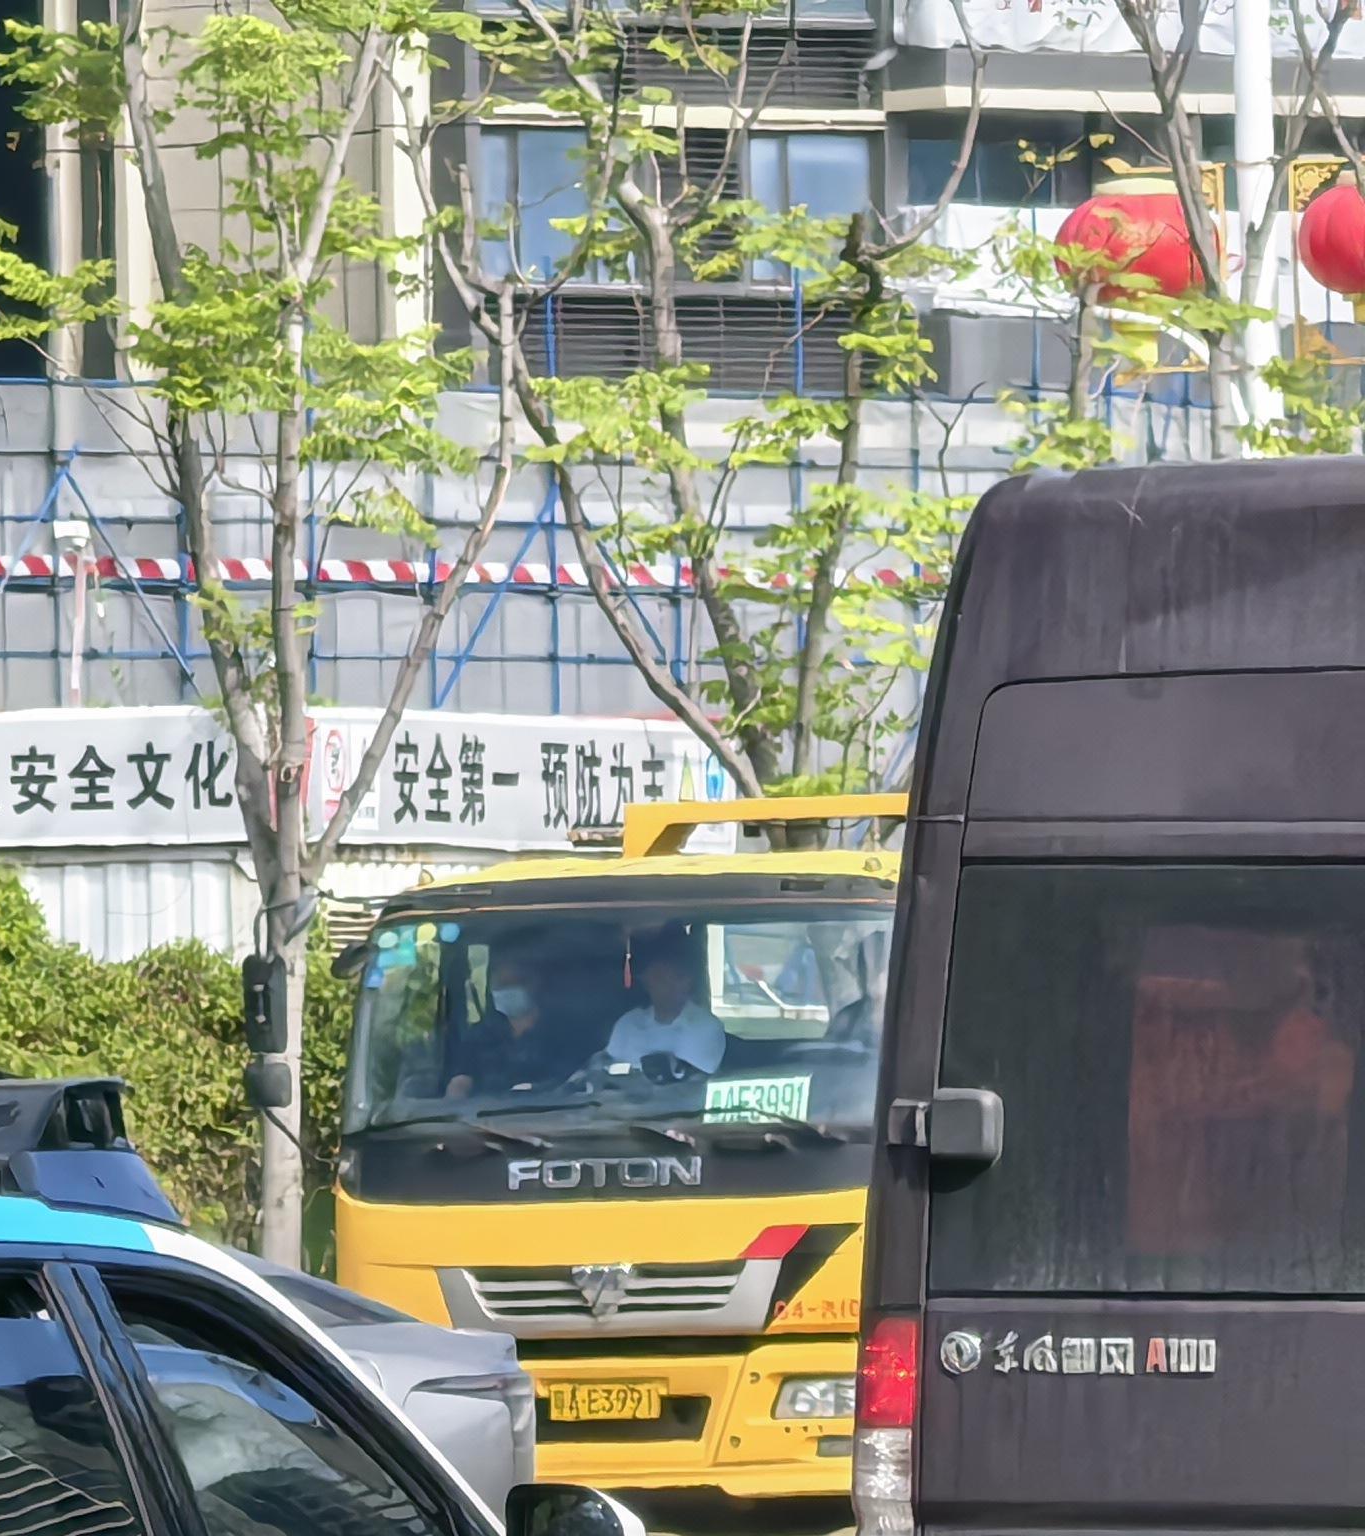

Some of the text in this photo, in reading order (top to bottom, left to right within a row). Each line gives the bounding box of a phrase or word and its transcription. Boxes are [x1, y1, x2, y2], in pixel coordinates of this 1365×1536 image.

[393, 731, 519, 825] 安全第一
[508, 1156, 702, 1190] FOTON
